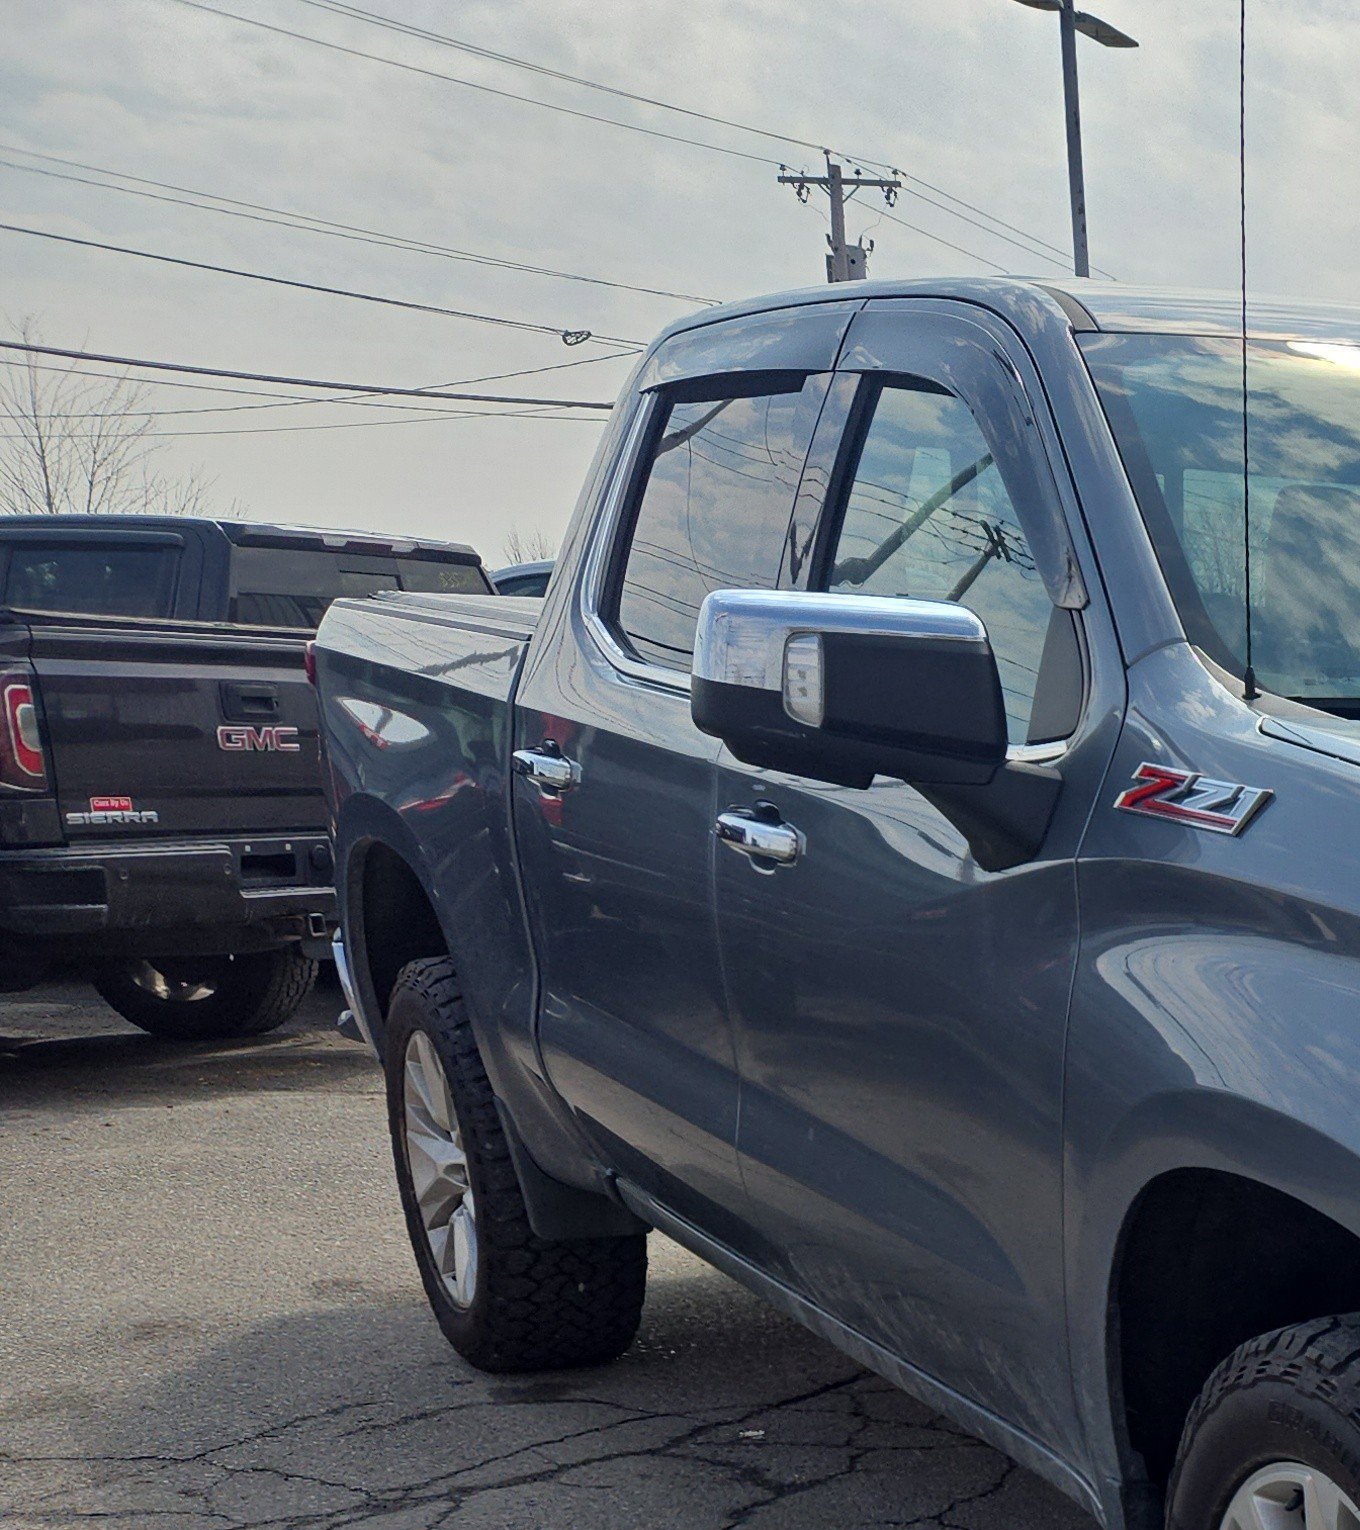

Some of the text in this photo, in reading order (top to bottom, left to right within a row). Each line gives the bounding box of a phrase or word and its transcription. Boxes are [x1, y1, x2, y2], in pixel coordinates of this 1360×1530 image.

[217, 726, 300, 751] GMC
[1113, 762, 1273, 837] Z71
[66, 811, 158, 824] SIERRA
